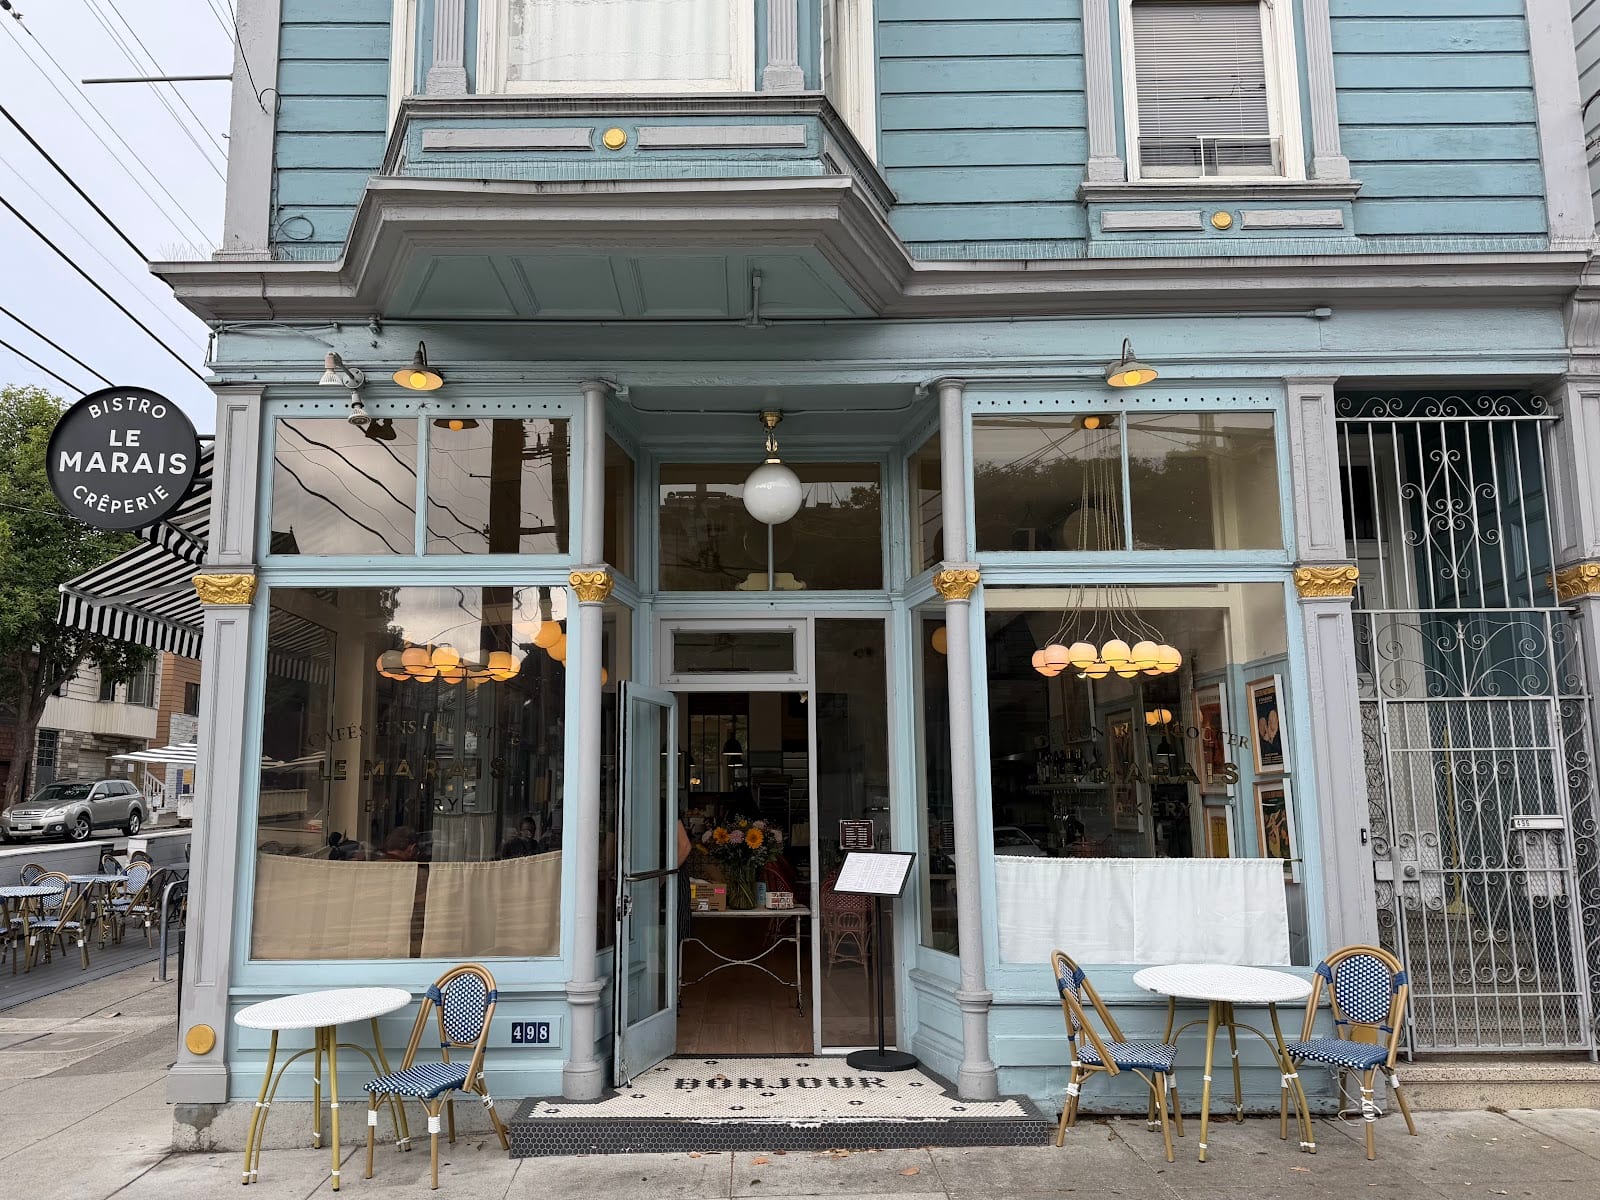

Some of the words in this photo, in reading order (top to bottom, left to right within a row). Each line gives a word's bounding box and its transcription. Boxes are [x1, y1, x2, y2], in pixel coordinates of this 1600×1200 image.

[88, 396, 167, 419] BISTRO
[109, 429, 141, 447] LE
[59, 451, 187, 475] MARAIS
[73, 484, 169, 514] CRÊPERIE
[318, 759, 347, 781] LE
[363, 757, 508, 781] MARAIS
[513, 1025, 548, 1041] 498
[674, 1076, 888, 1090] BONJOUR
